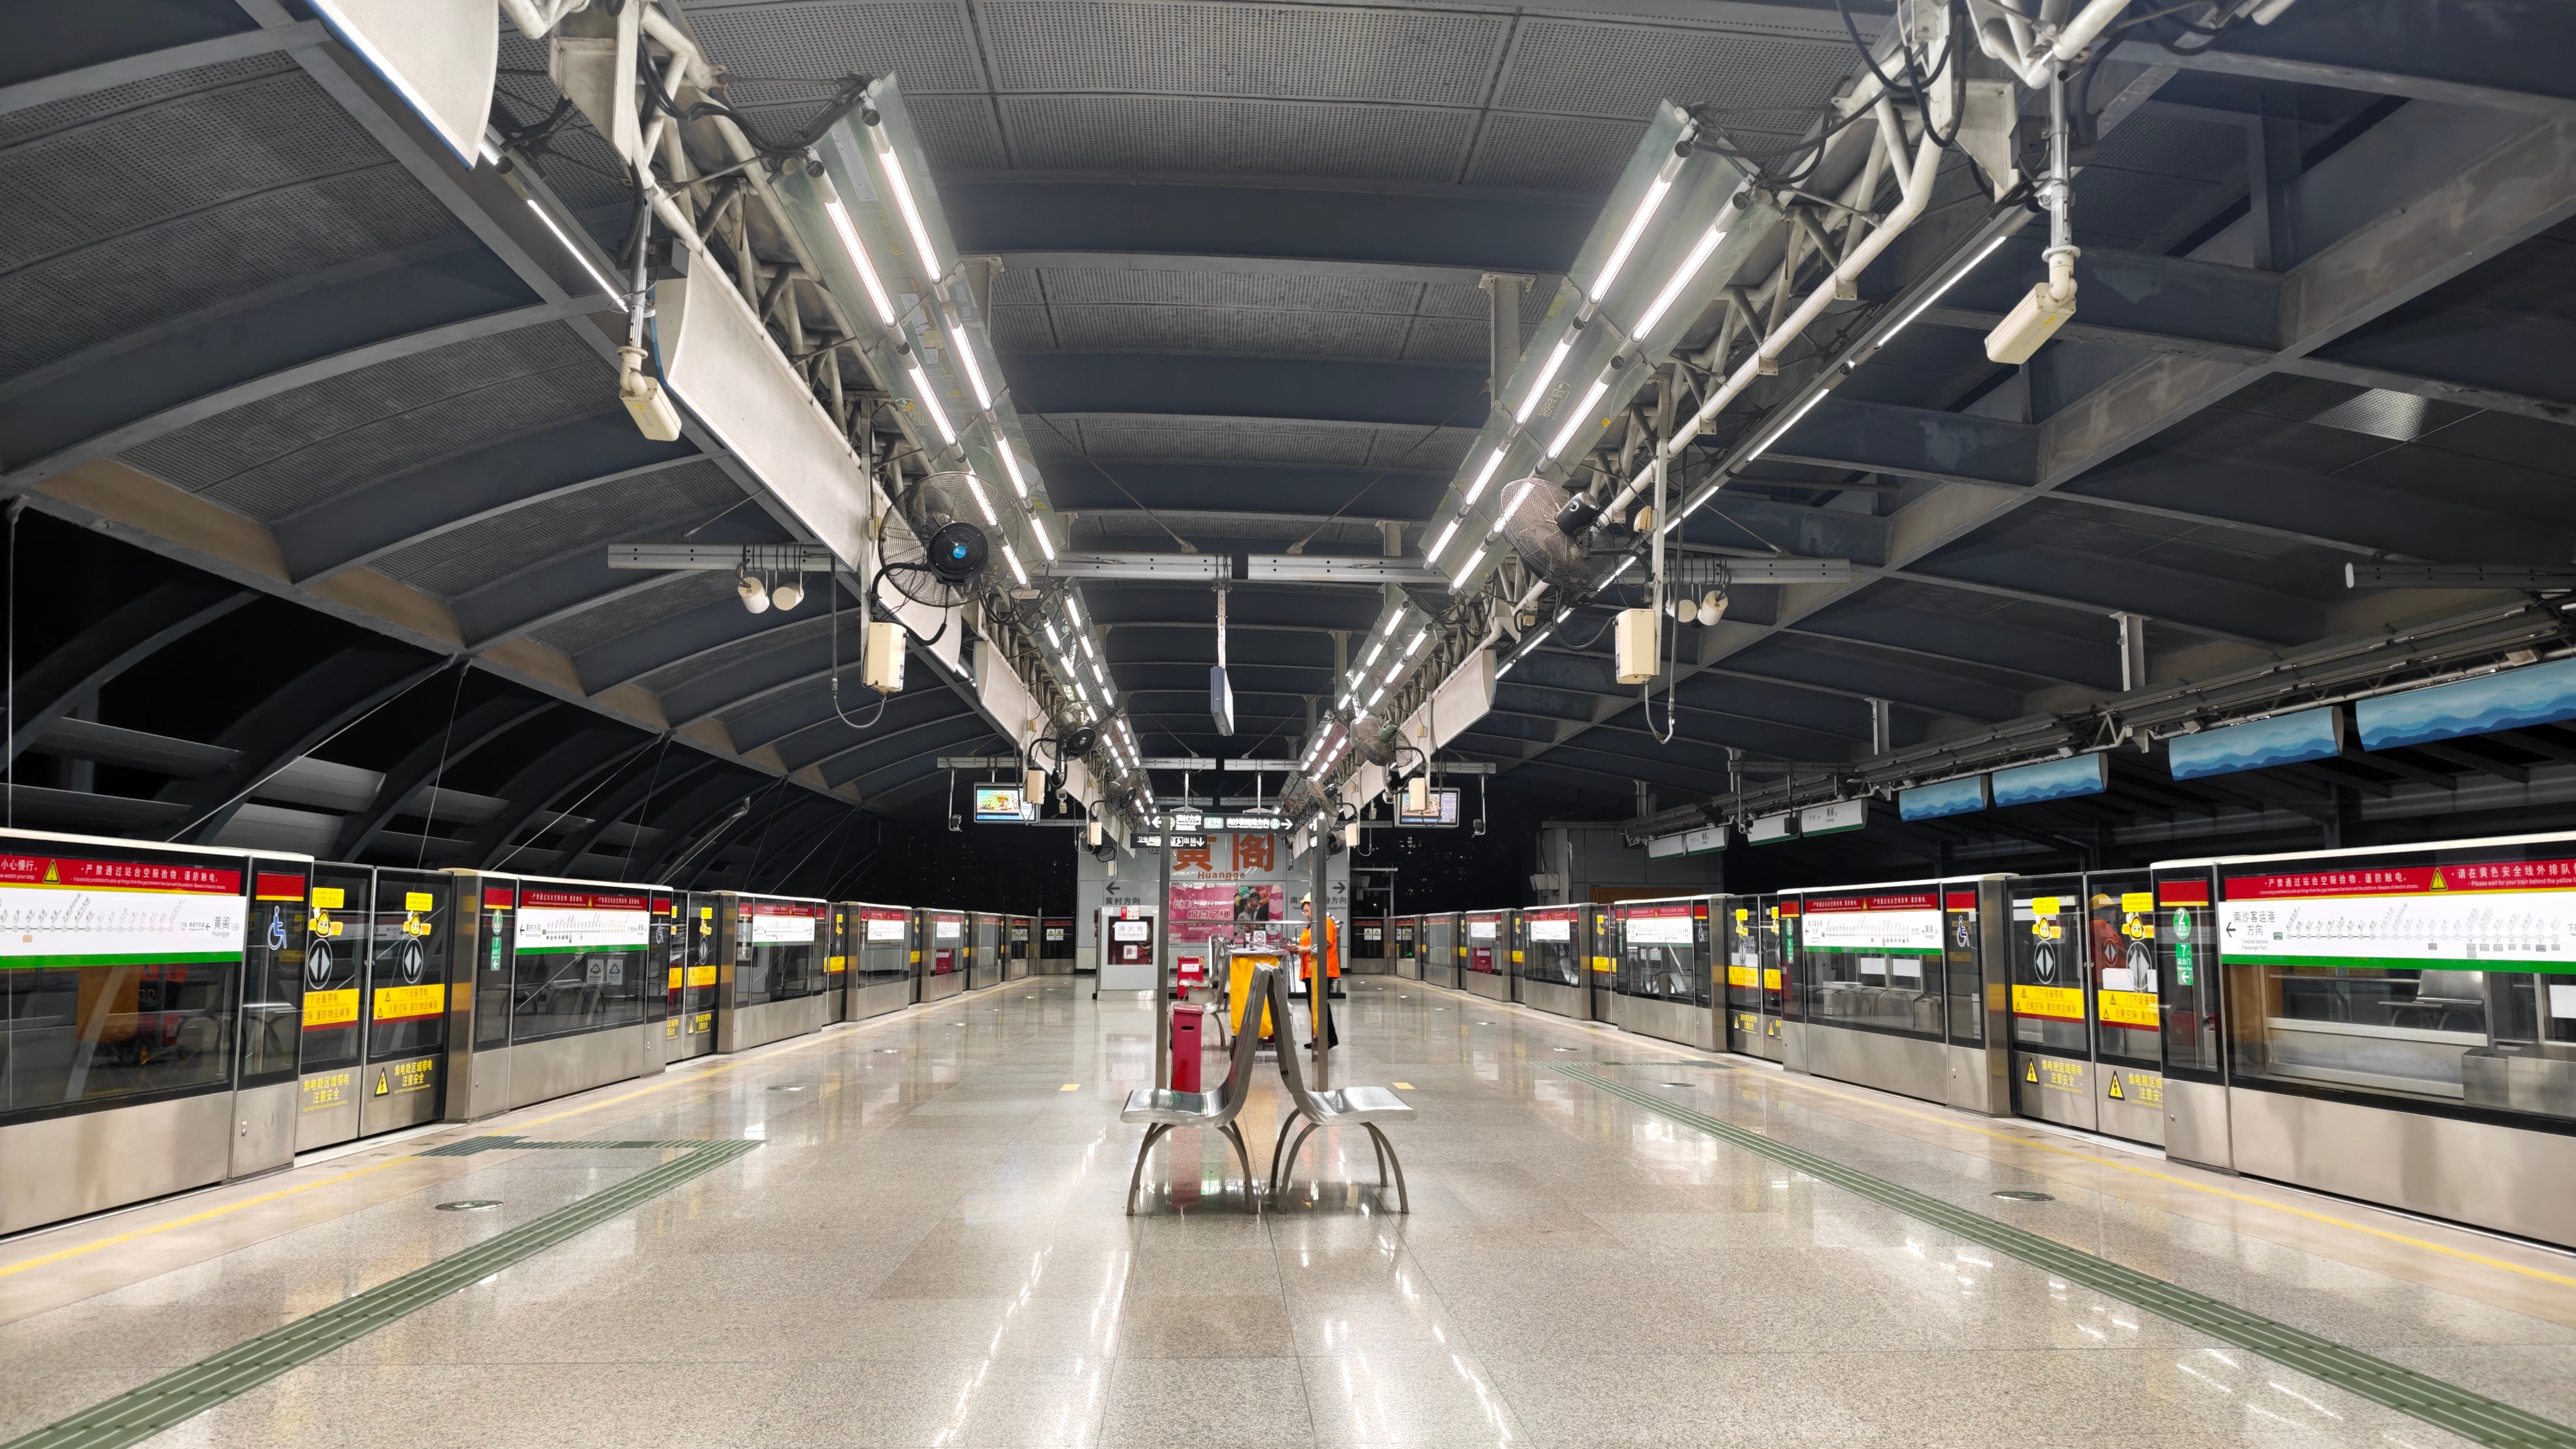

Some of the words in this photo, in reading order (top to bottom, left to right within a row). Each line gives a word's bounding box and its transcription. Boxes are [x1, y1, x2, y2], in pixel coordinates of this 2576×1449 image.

[1197, 871, 1245, 880] Huangge
[2458, 863, 2576, 879] 请在黄色安全线外排队
[1105, 897, 1141, 905] 黄村方向
[214, 916, 230, 930] 黄阁
[2178, 909, 2185, 925] 2
[2233, 910, 2275, 923] 南沙客运港
[2246, 924, 2263, 936] 方向
[2180, 945, 2187, 957] 7
[2126, 994, 2158, 1006] 门下设备带
[394, 1059, 433, 1077] 集电靴区域带电
[2041, 1059, 2083, 1076] 集电靴区域带电
[303, 1073, 350, 1092] 集电靴区域带电
[401, 1073, 425, 1087] 注意安全
[2051, 1072, 2074, 1087] 注意安全
[312, 1088, 340, 1104] 注意安全
[2139, 1087, 2163, 1102] 注意安
